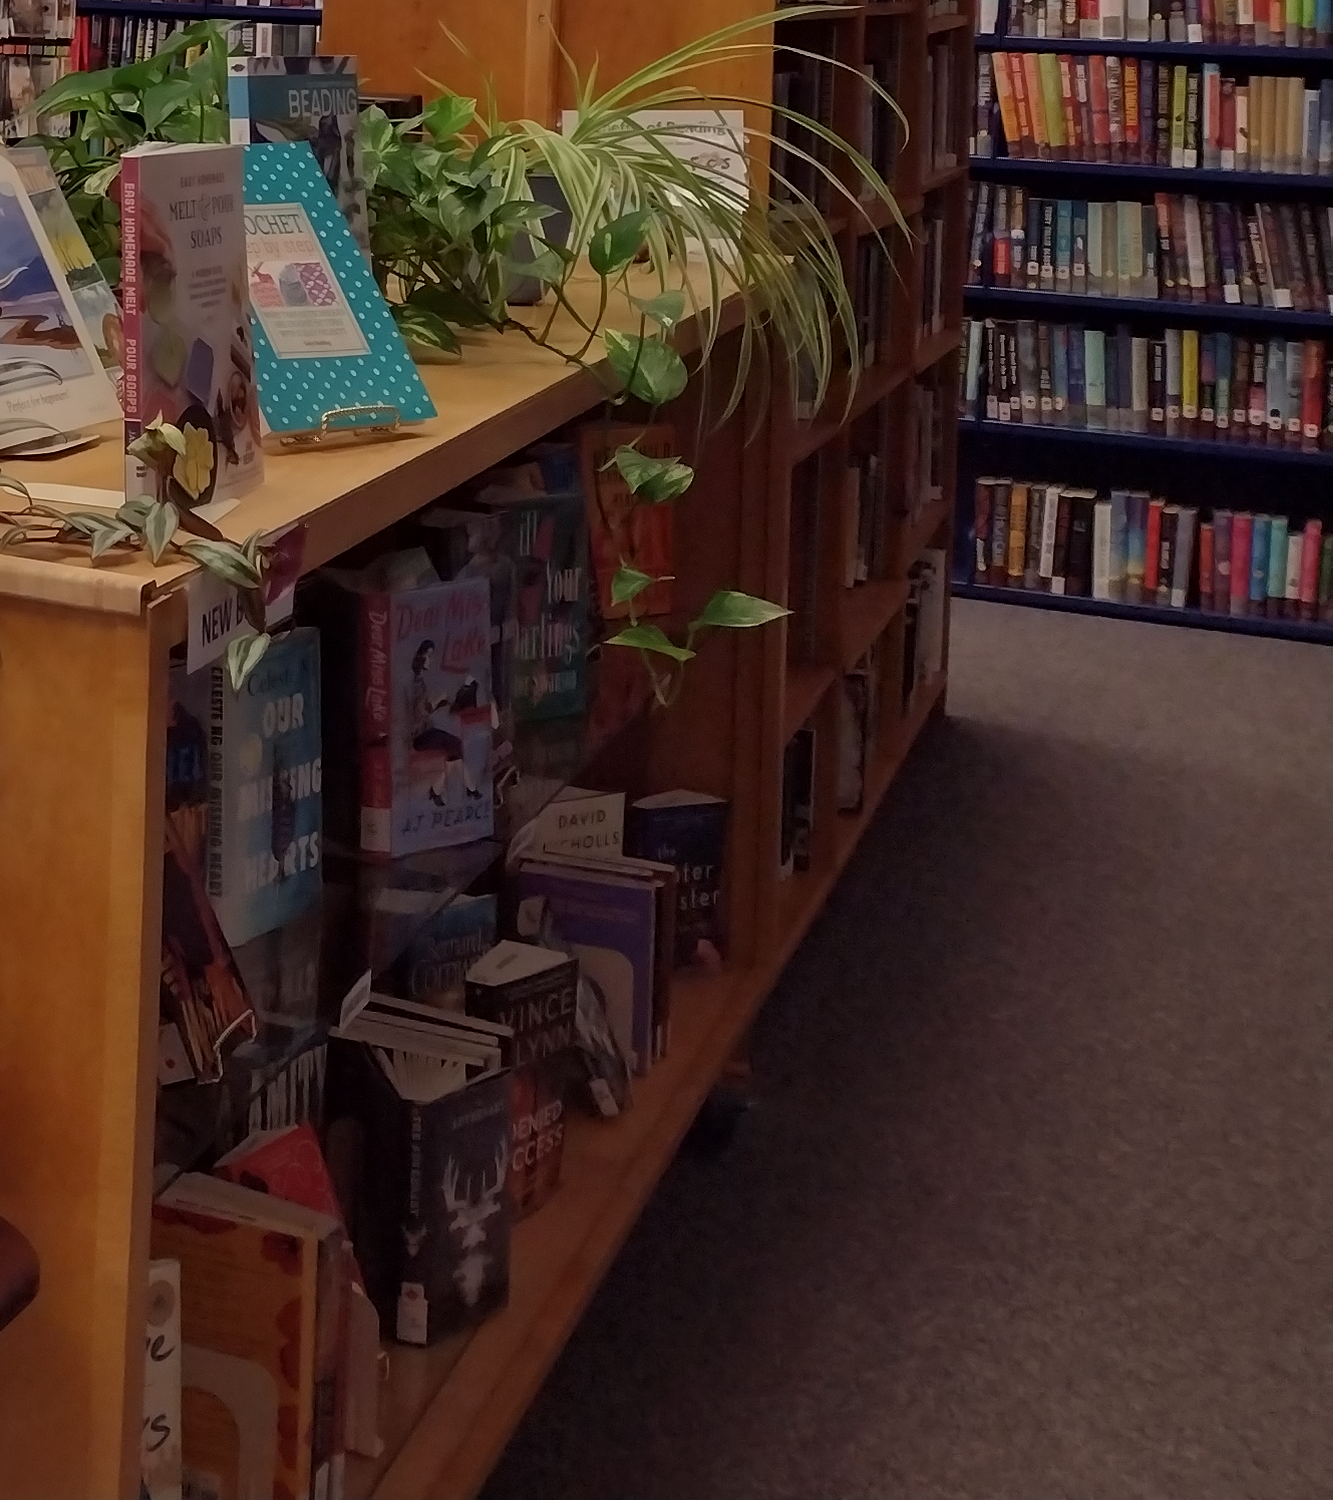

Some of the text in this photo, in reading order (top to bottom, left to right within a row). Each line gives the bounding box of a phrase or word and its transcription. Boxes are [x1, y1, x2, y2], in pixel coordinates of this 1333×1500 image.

[288, 88, 357, 119] BEADING
[169, 199, 198, 223] MELT
[190, 226, 223, 249] SOAPS
[262, 238, 280, 259] by
[282, 239, 315, 257] step
[124, 182, 137, 414] EASY HOMEMADE MELT POUR SOAPS
[201, 598, 233, 648] NEW
[210, 667, 223, 721] CELESTE
[262, 692, 305, 739] OUR
[557, 809, 607, 830] DAVID
